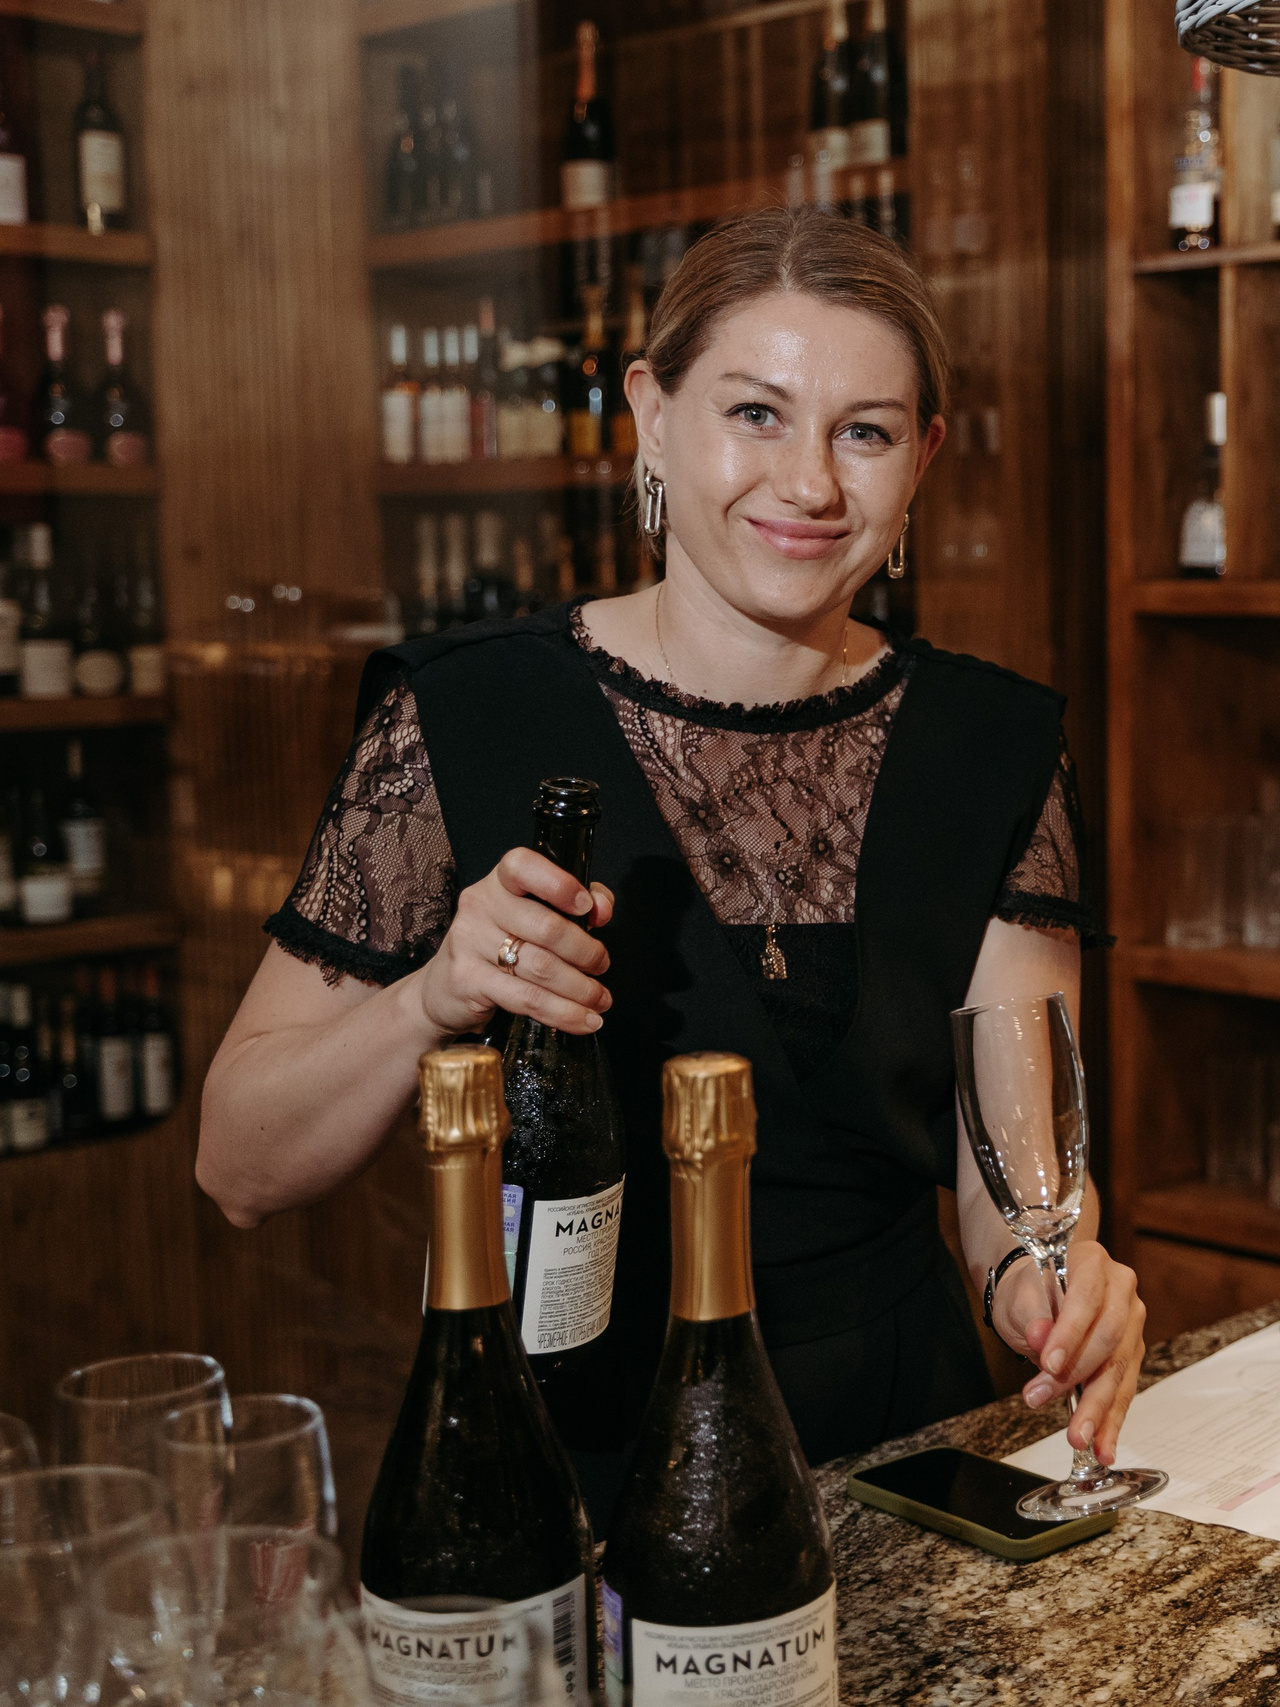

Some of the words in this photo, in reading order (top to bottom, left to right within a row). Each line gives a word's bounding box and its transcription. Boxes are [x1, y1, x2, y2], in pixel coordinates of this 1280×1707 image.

[555, 1201, 620, 1237] MAGNA
[656, 1622, 826, 1676] MAGNATUM
[684, 1674, 721, 1689] МЕСТО
[774, 1687, 794, 1702] 2020
